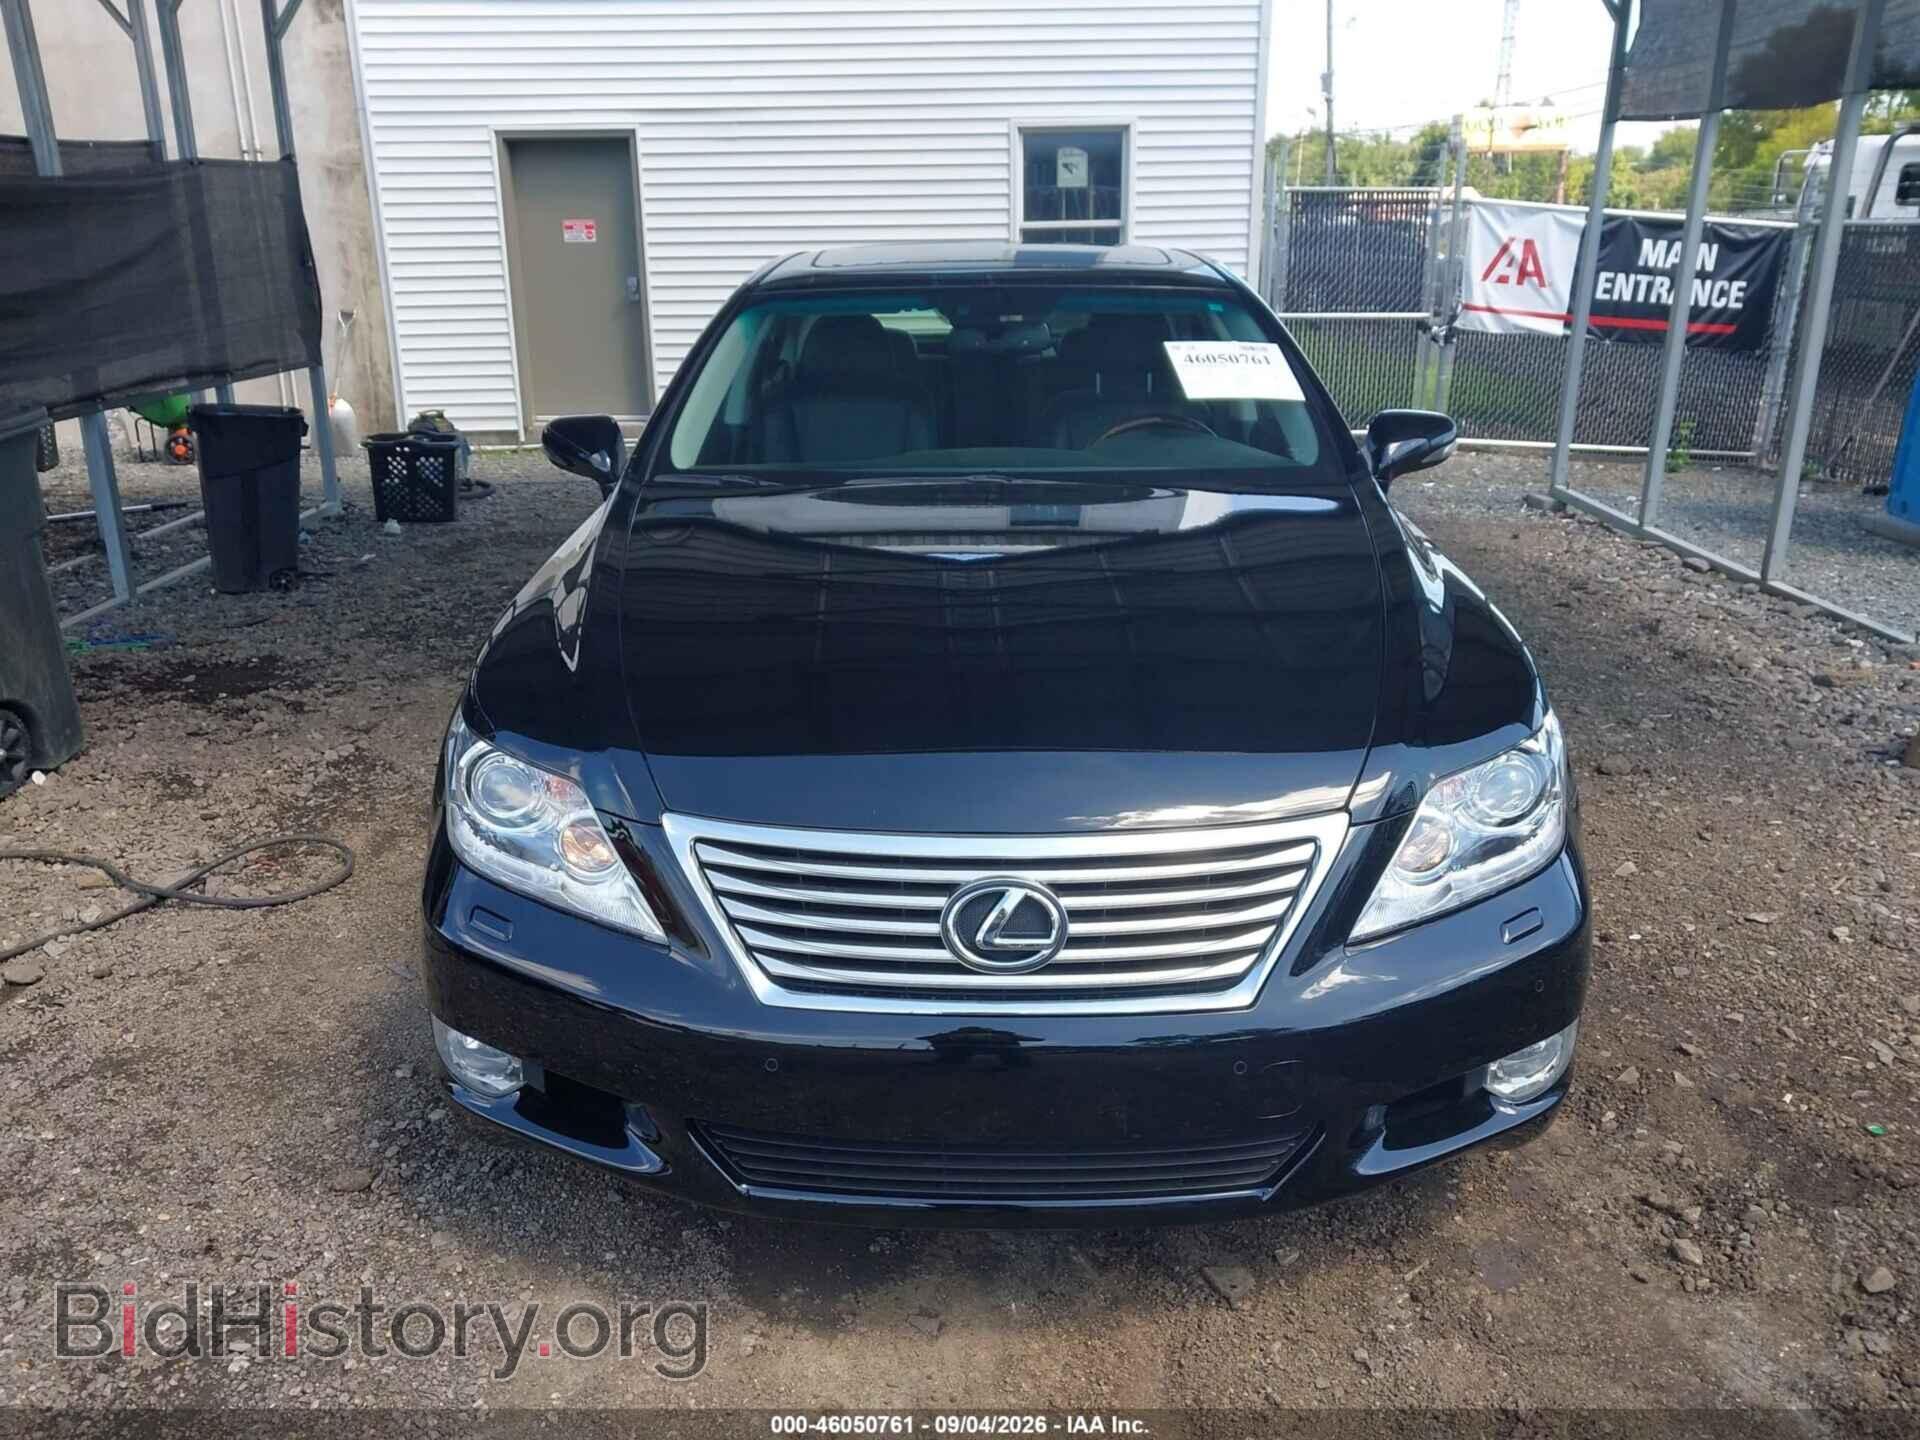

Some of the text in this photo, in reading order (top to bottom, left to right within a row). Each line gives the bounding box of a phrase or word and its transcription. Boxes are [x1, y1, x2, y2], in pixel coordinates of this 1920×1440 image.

[1638, 238, 1719, 272] MAN
[1595, 271, 1747, 309] ENTRNCE
[1184, 353, 1271, 365] 46050761
